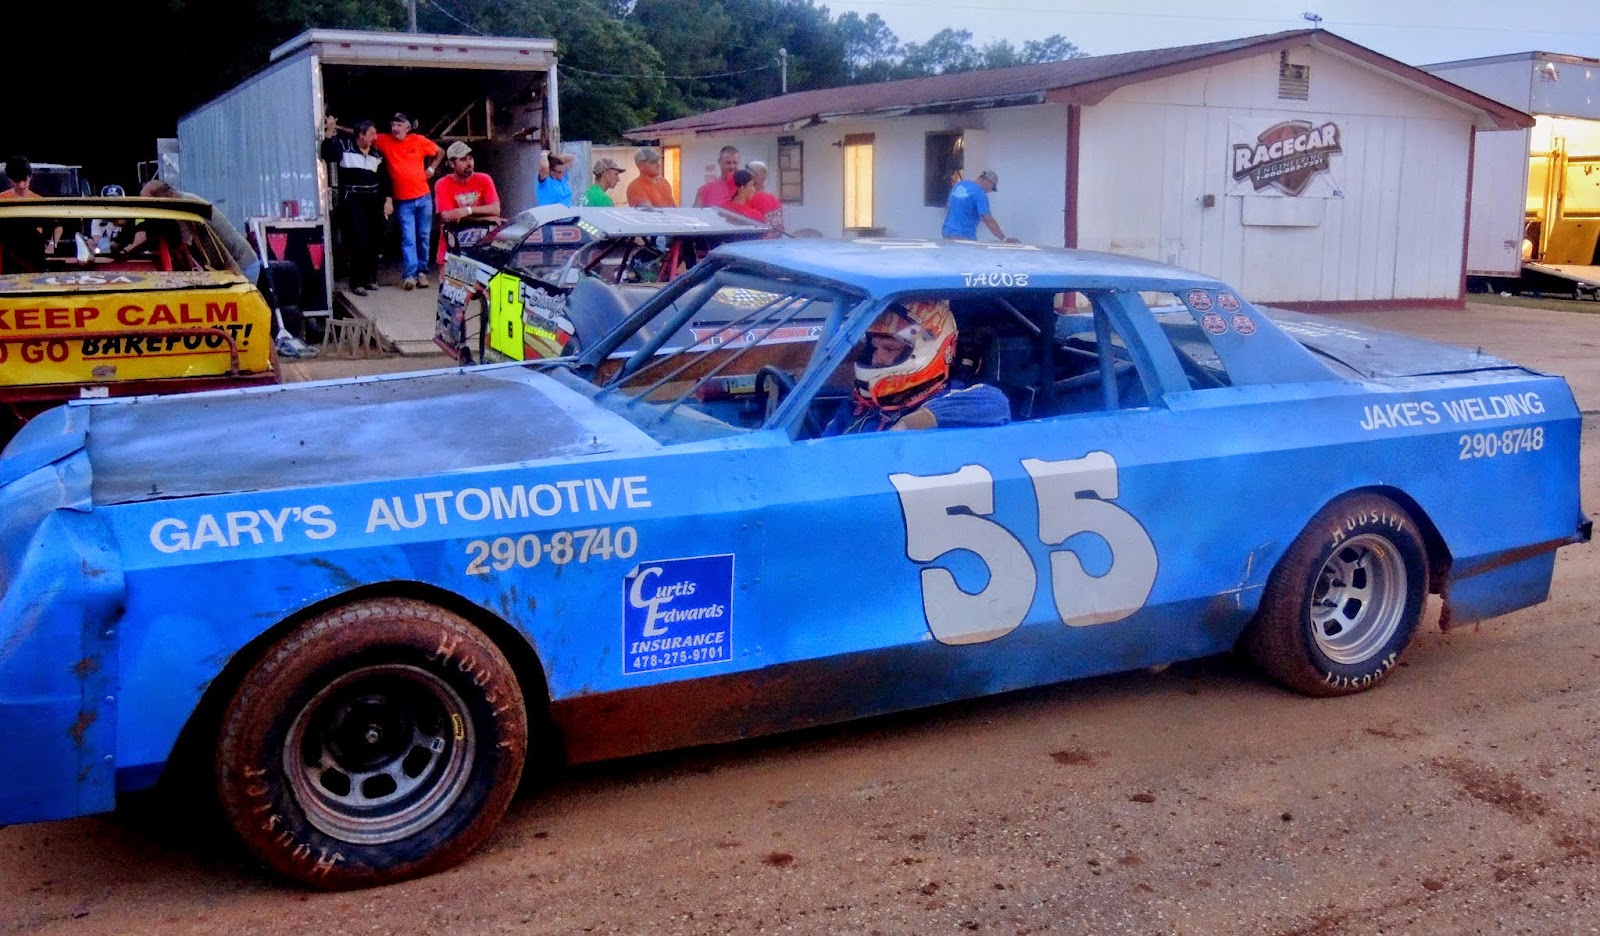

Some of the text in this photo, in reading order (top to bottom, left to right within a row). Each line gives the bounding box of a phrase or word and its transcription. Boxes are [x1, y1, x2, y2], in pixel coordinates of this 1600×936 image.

[1233, 122, 1340, 177] RACECAR
[1257, 153, 1324, 176] ENGINEERING
[961, 272, 1029, 287] JACOB
[117, 302, 239, 326] CALM
[21, 340, 69, 364] GO
[82, 324, 253, 357] BAREFOOT!
[1360, 391, 1546, 431] JAKE'S WELDING
[1458, 426, 1545, 460] 290-8748
[150, 475, 652, 554] GARY'S AUTOMOTIVE
[465, 526, 638, 575] 290-8740
[888, 450, 1160, 646] 55
[629, 567, 696, 609] Curtis
[643, 596, 725, 637] Edwards
[630, 631, 725, 655] INSURANCE
[633, 646, 723, 669] 478-275-9701
